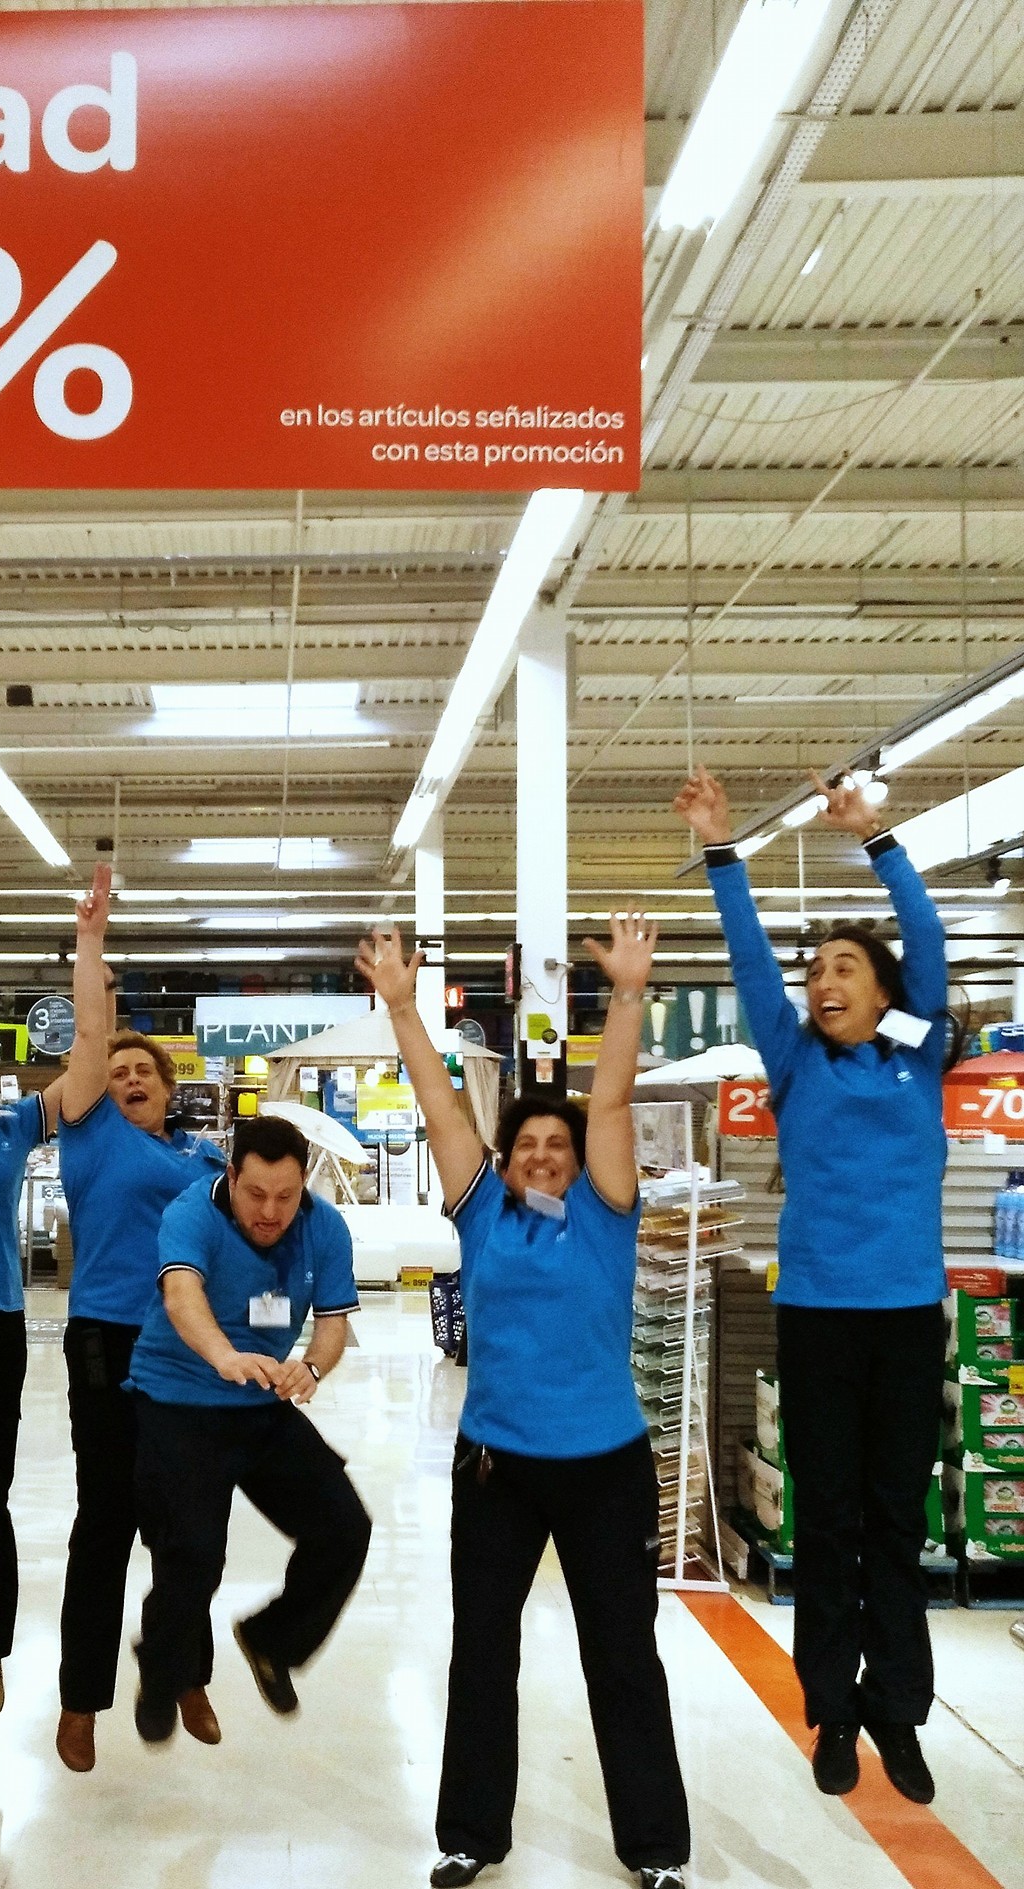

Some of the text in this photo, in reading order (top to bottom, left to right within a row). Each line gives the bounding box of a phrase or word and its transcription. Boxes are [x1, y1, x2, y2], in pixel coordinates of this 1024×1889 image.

[279, 403, 624, 430] en los artículos señalizados
[371, 439, 624, 467] con esta promoción
[36, 1008, 50, 1030] 3
[202, 1015, 339, 1043] PLANTA
[173, 1062, 196, 1075] 99
[44, 1187, 55, 1200] 3
